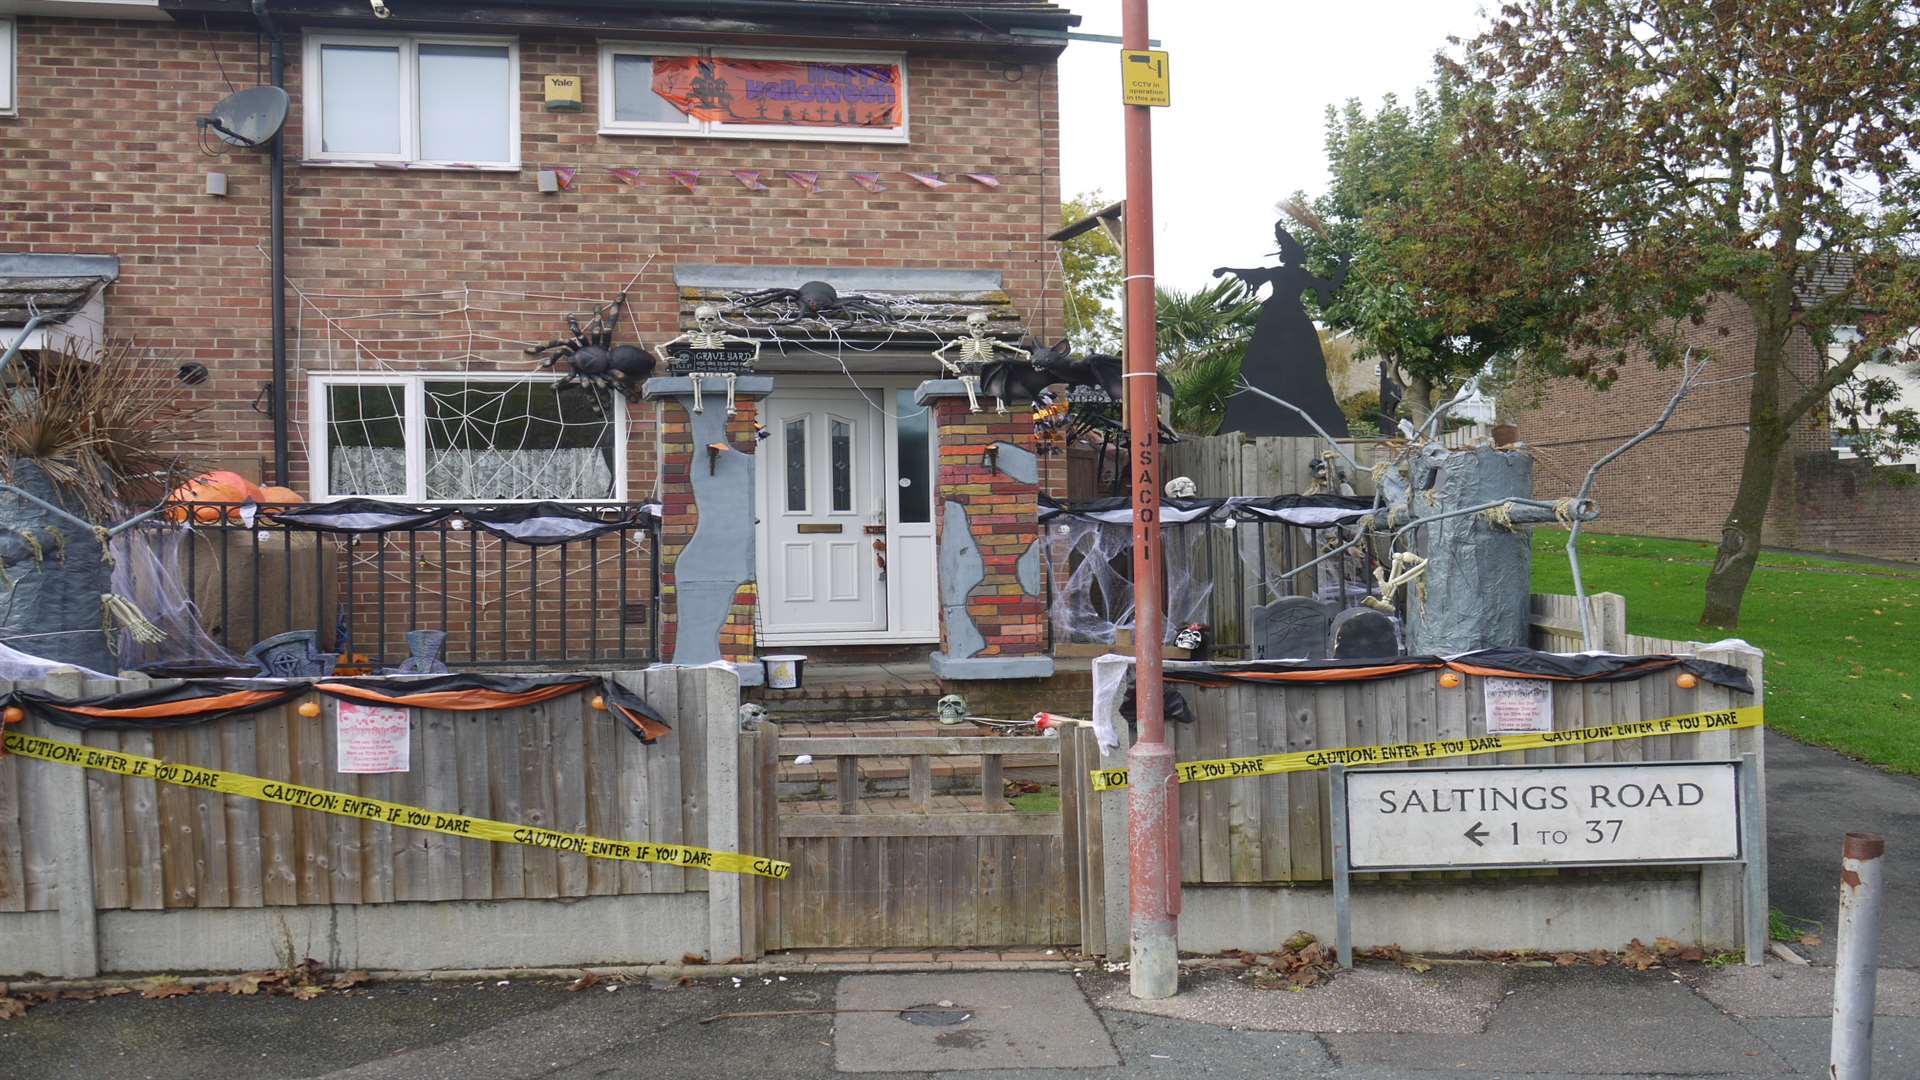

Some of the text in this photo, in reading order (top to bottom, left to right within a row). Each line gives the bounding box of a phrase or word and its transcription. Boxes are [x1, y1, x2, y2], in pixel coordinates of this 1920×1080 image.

[551, 78, 574, 87] Yale
[695, 351, 725, 361] GRAVE
[1542, 711, 1738, 743] CAUTION: ENTER IF YOU DARE
[3, 735, 220, 788] CAUTION: ENTER IF YOU DARE
[1306, 736, 1502, 767] CAUTION: ENTER IF YOU DARE
[1184, 765, 1198, 780] IF
[1202, 762, 1226, 777] YOU
[1231, 758, 1265, 776] DARE
[262, 784, 471, 834] CAUTION: ENTER IF YOU DARE
[1379, 782, 1705, 814] SALTINGS ROAD
[513, 828, 712, 867] CAUTION: ENTER IF YOU DARE
[1511, 819, 1624, 846] 1 TO 37
